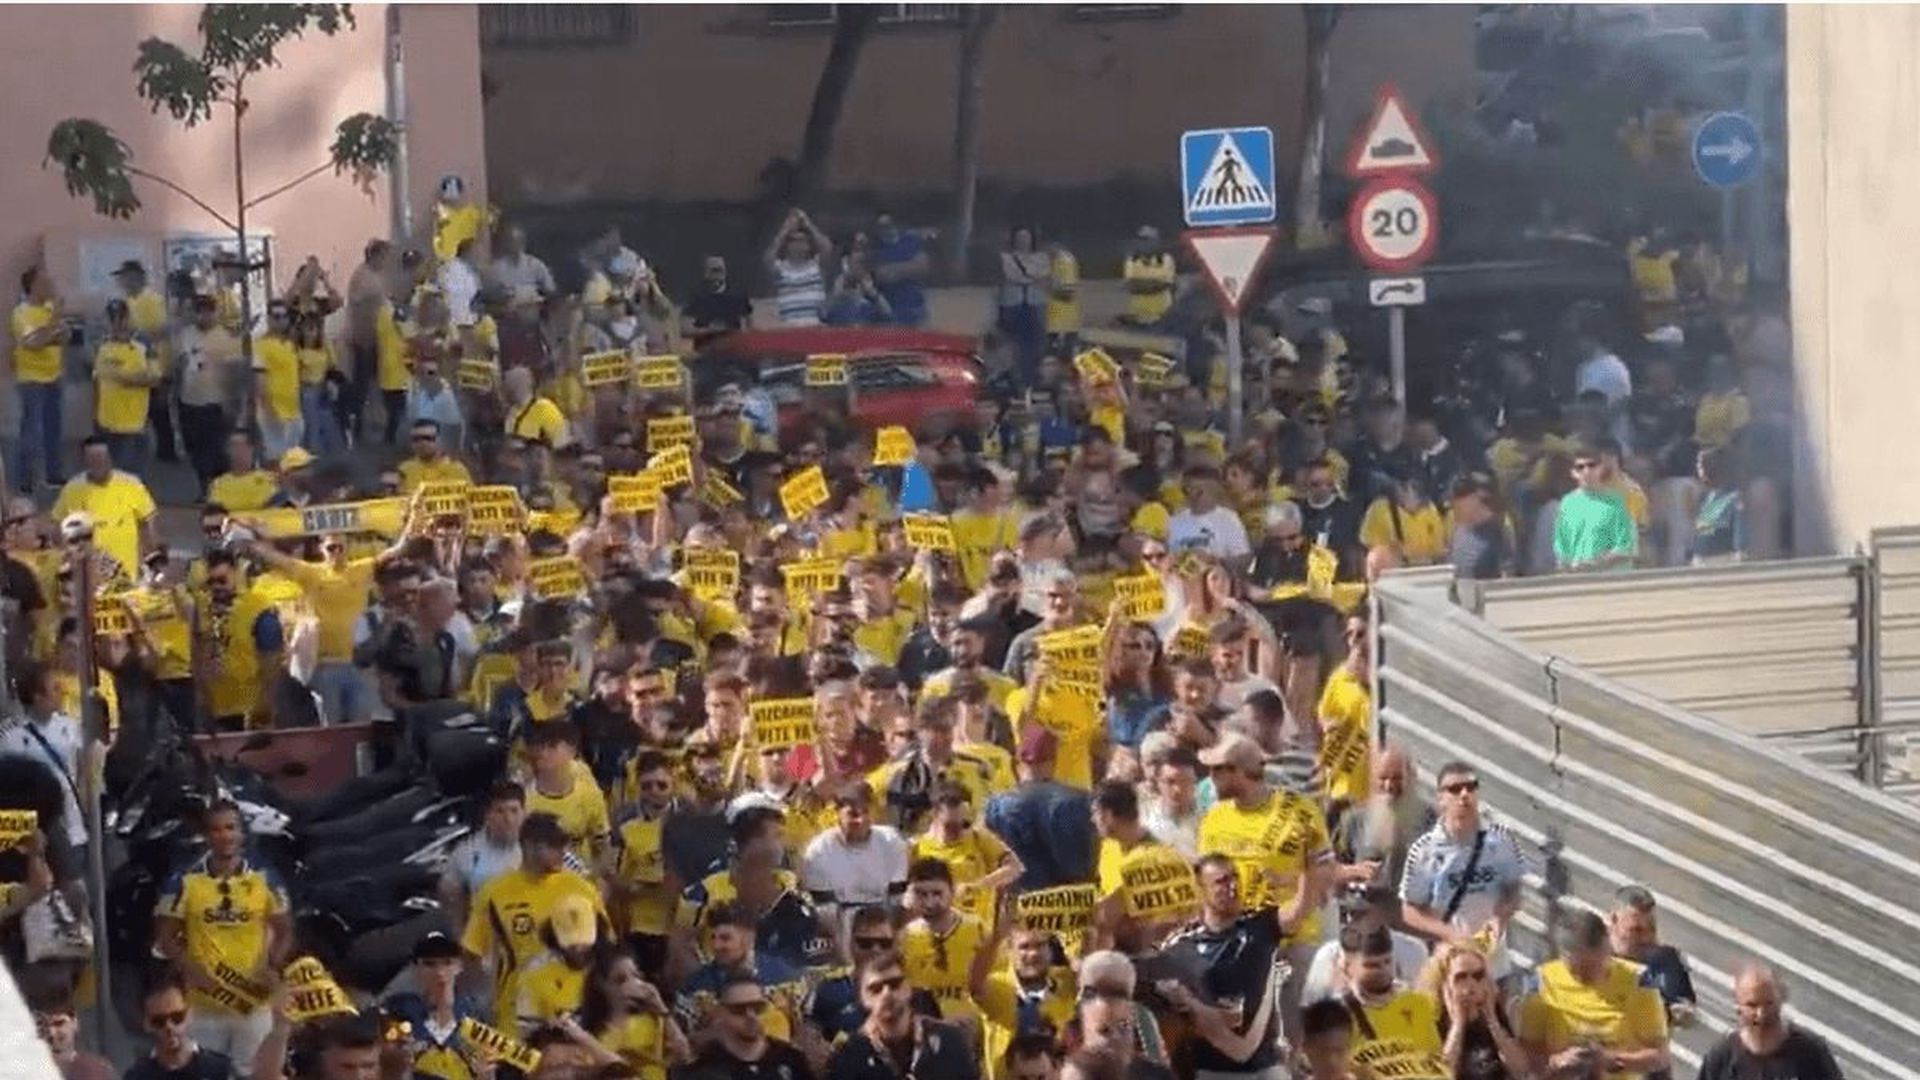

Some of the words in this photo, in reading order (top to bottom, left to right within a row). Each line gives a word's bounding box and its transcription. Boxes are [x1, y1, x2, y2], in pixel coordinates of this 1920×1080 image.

[1372, 207, 1418, 238] 20
[754, 705, 814, 722] VIZCAINO
[757, 726, 788, 743] VETE
[794, 723, 812, 740] YA
[1122, 862, 1192, 888] VIZCAINO
[1020, 888, 1096, 908] VIZCAINO
[1133, 887, 1171, 910] VETE
[1025, 912, 1063, 930] VETE
[294, 987, 336, 1011] VETE
[470, 1021, 508, 1053] VETE
[511, 1045, 533, 1065] YA
